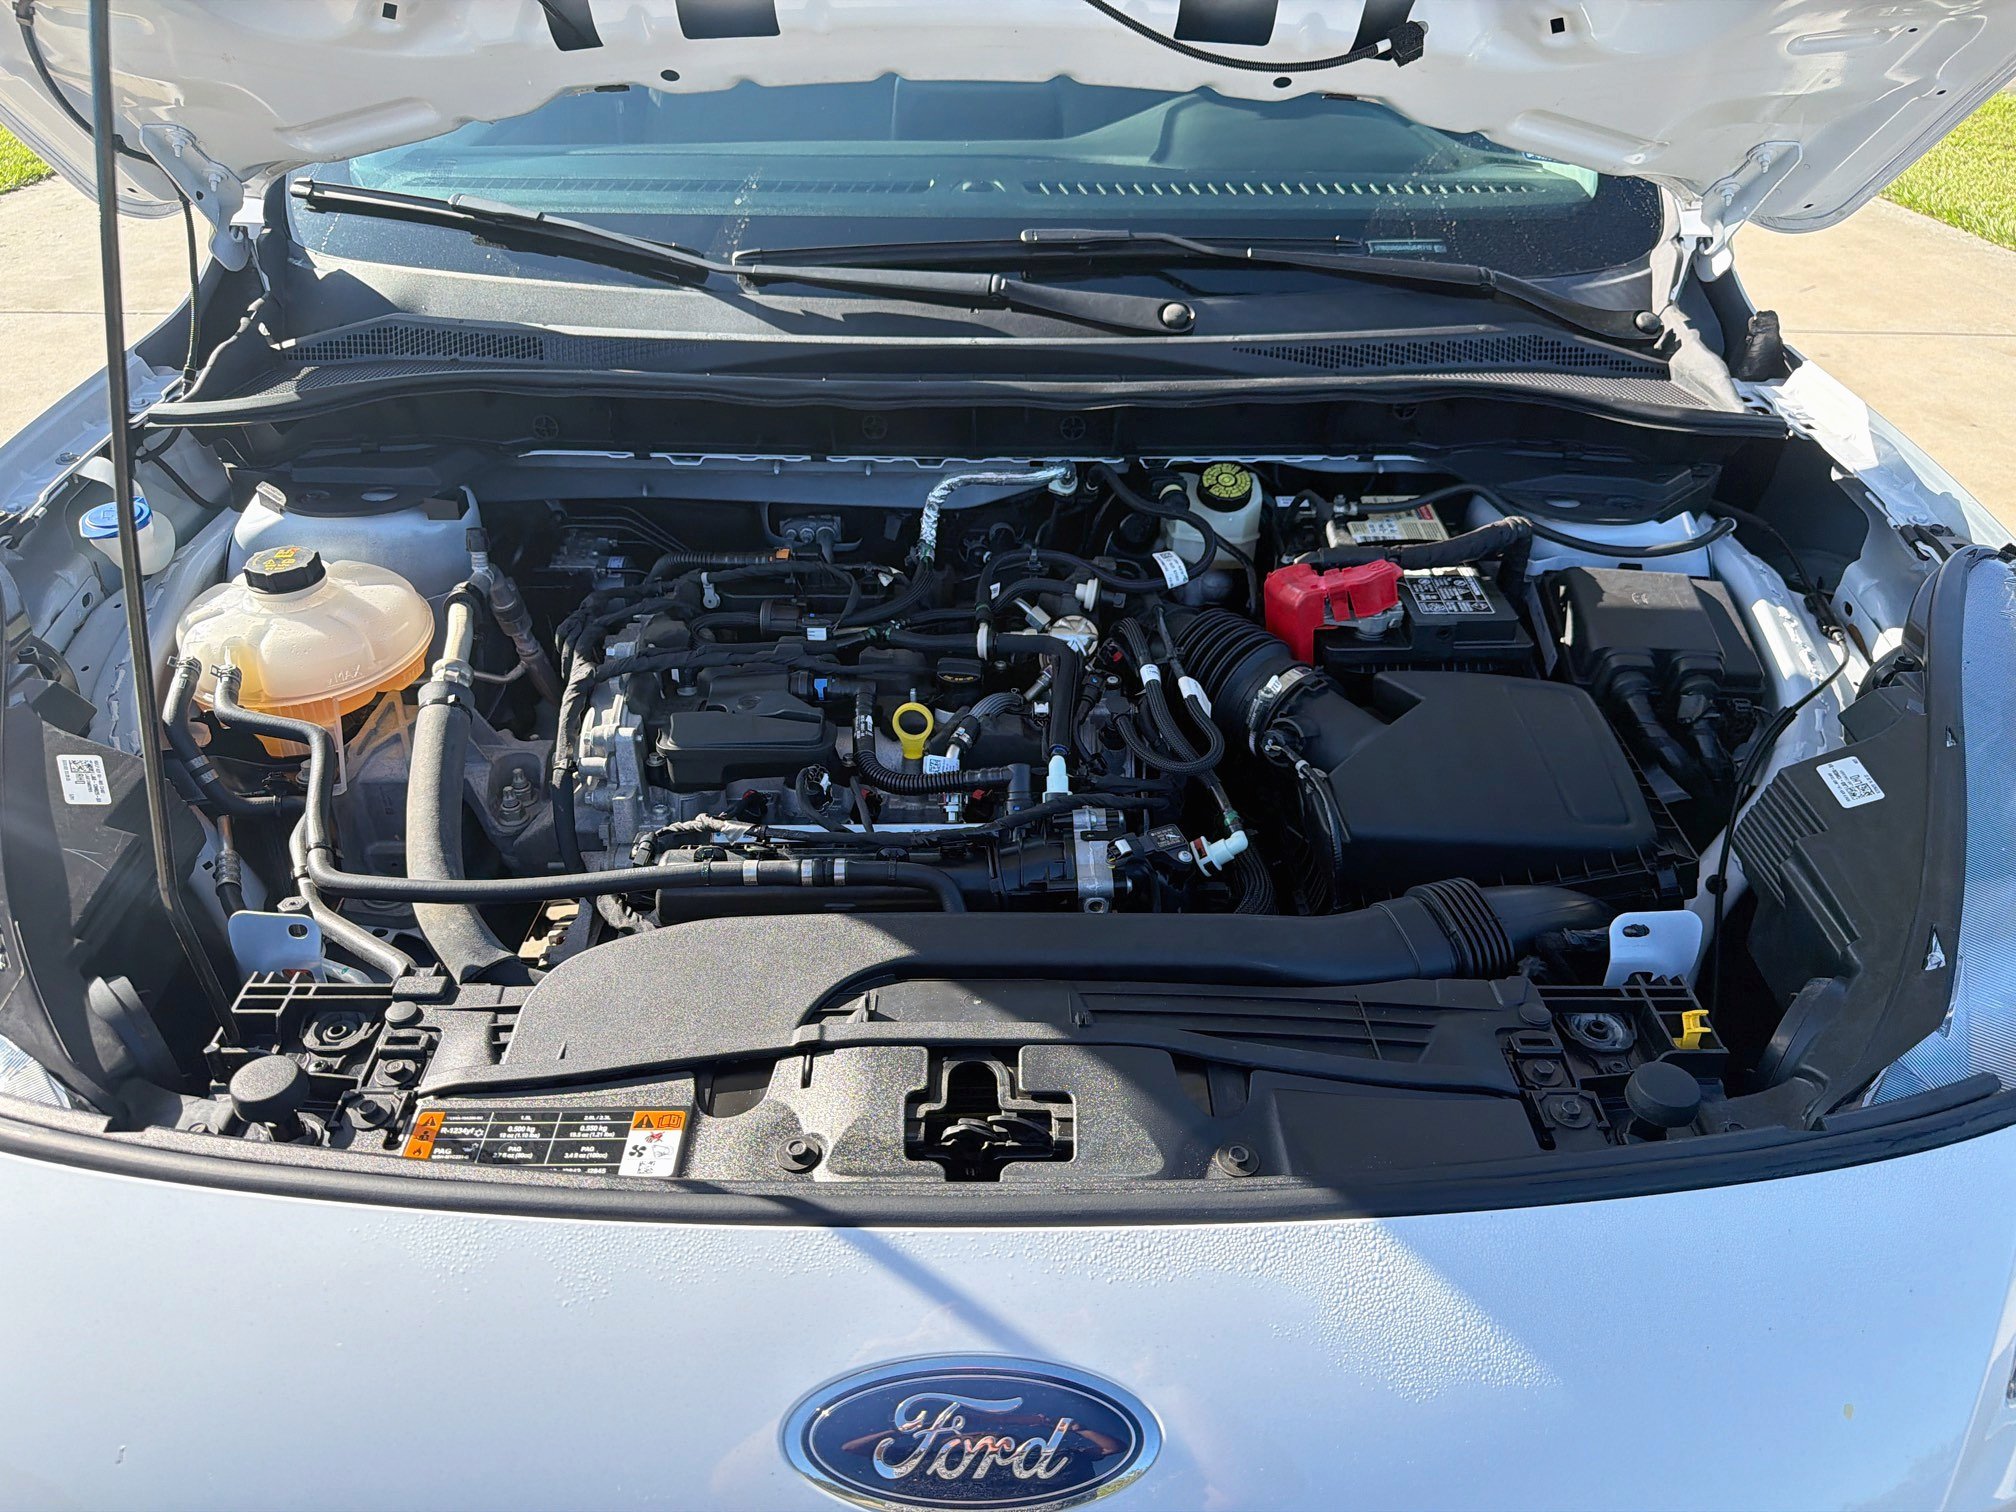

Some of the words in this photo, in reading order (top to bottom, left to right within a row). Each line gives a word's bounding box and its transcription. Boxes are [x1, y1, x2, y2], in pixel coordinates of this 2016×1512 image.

[440, 1127, 475, 1136] R-1234yf
[526, 1126, 535, 1134] kg
[433, 1147, 452, 1155] PAG
[872, 1392, 1072, 1480] Ford
